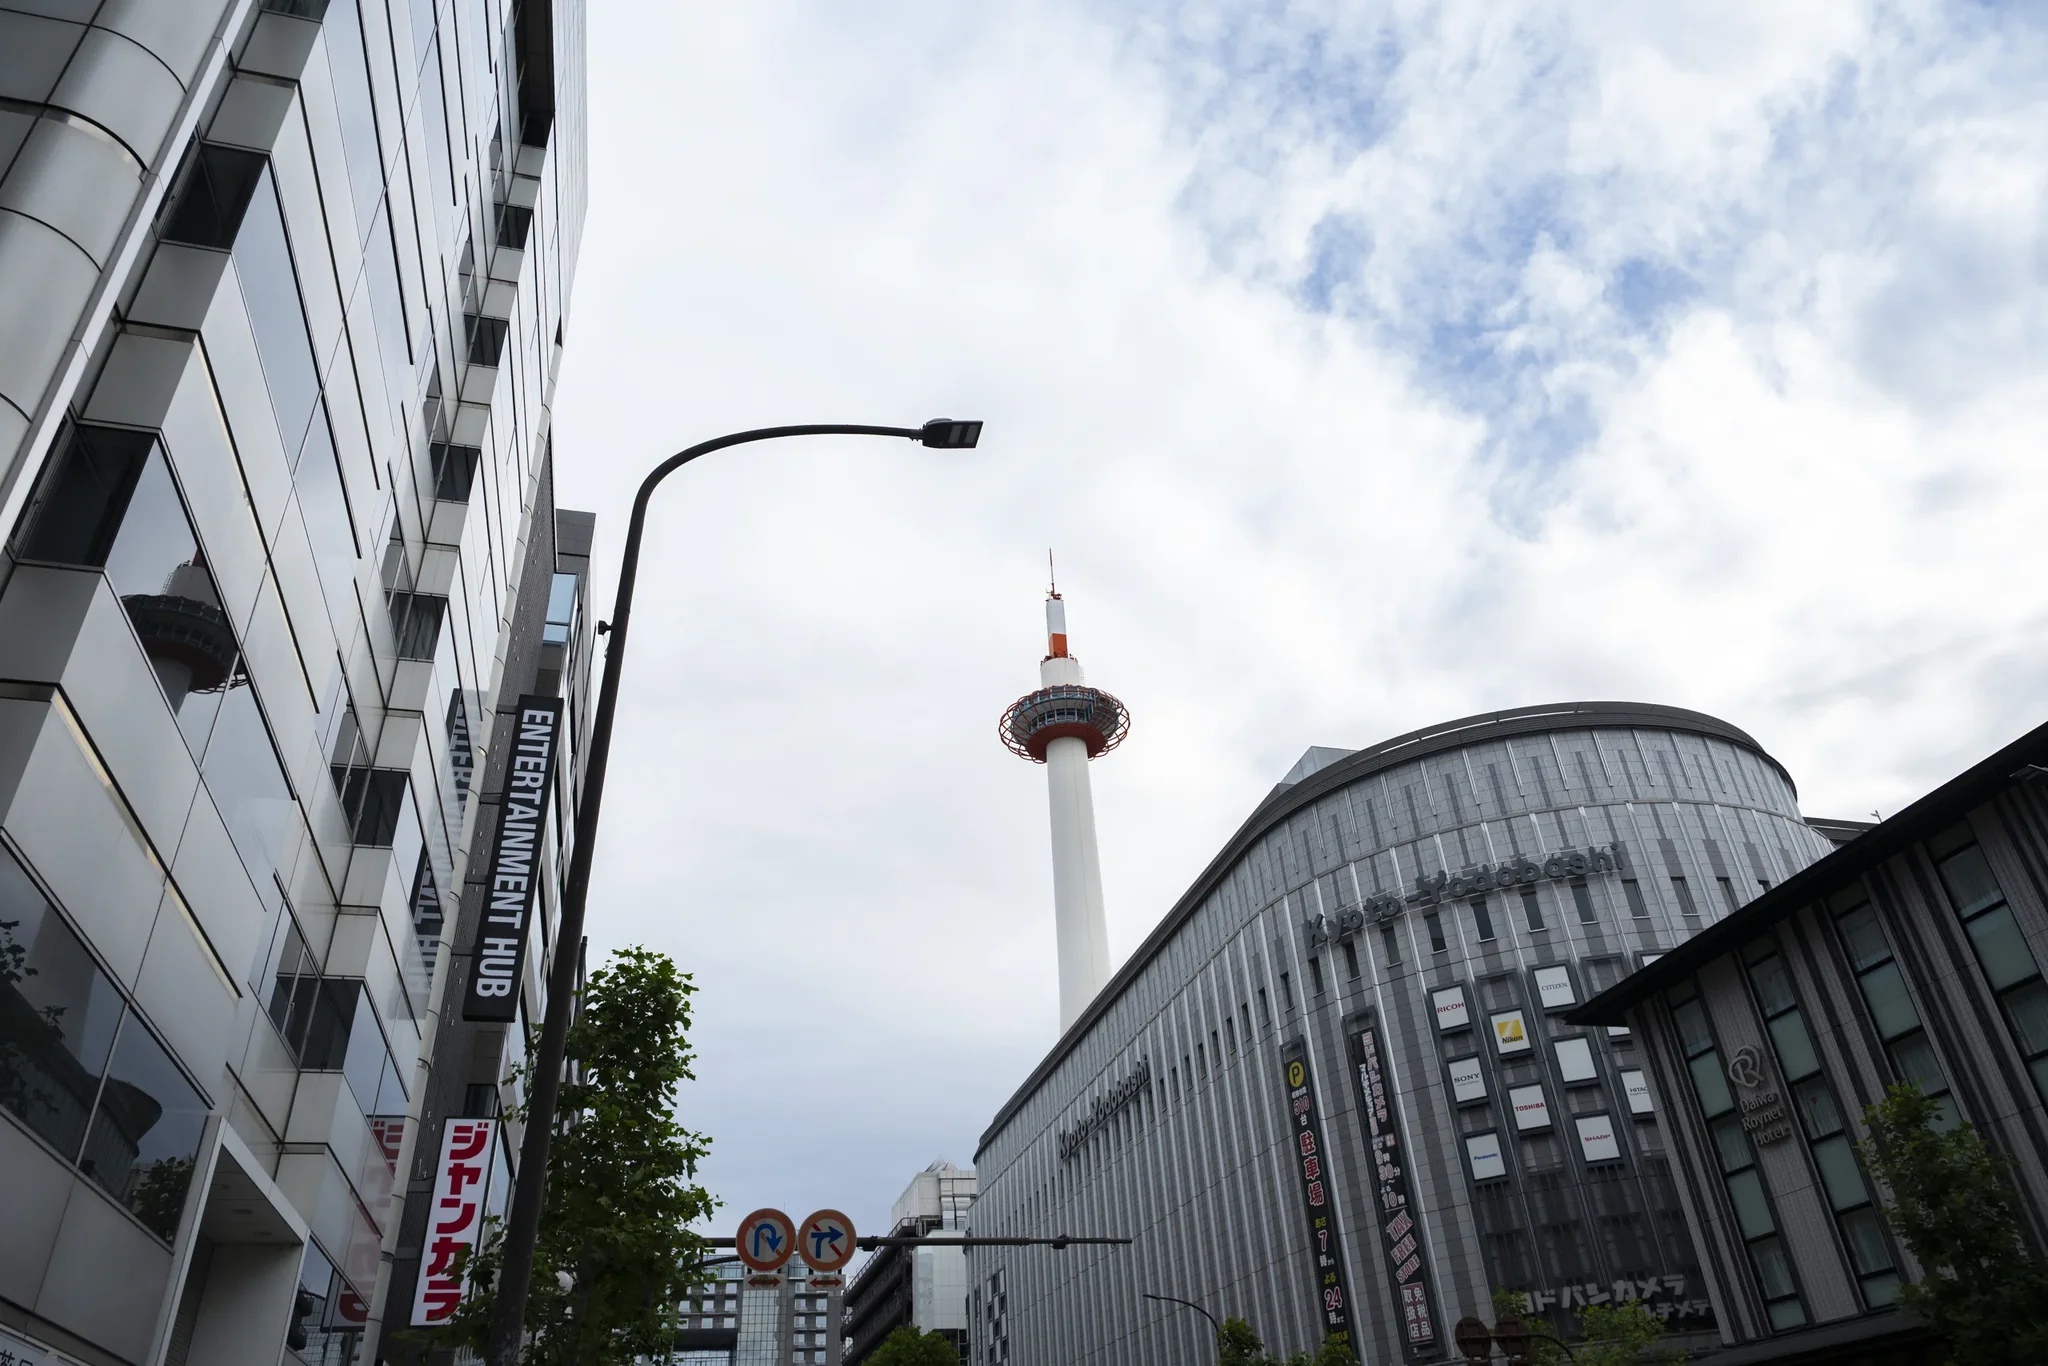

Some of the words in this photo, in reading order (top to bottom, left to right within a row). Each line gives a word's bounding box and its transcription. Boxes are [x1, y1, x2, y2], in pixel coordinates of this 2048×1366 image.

[487, 708, 555, 930] ENTERTAINMENT
[1302, 843, 1625, 948] Kyoto-Yodobashi
[476, 937, 518, 998] HUB
[1541, 982, 1568, 991] CITIZEN
[1436, 1002, 1465, 1014] RICOH
[1502, 1035, 1524, 1044] Nikon
[1361, 1031, 1388, 1123] ヨドバシカメラ
[1453, 1073, 1480, 1083] SONY
[1515, 1102, 1545, 1112] TOSHIBA
[1740, 1091, 1774, 1113] Daiwa
[1300, 1114, 1308, 1126] 台
[1742, 1107, 1783, 1131] Roynet
[1584, 1133, 1611, 1142] SHARP
[1752, 1123, 1785, 1145] Hotel
[1300, 1130, 1324, 1206] 駐車場
[1473, 1152, 1498, 1161] Panasonic
[423, 1122, 489, 1322] ジャンカラ
[1386, 1209, 1413, 1242] TAX
[1318, 1230, 1327, 1252] 7
[1390, 1233, 1417, 1266] FREE
[1395, 1254, 1420, 1283] STORE
[1324, 1286, 1342, 1310] 24
[1403, 1289, 1420, 1338] 取扱店
[1413, 1287, 1431, 1337] 免税品
